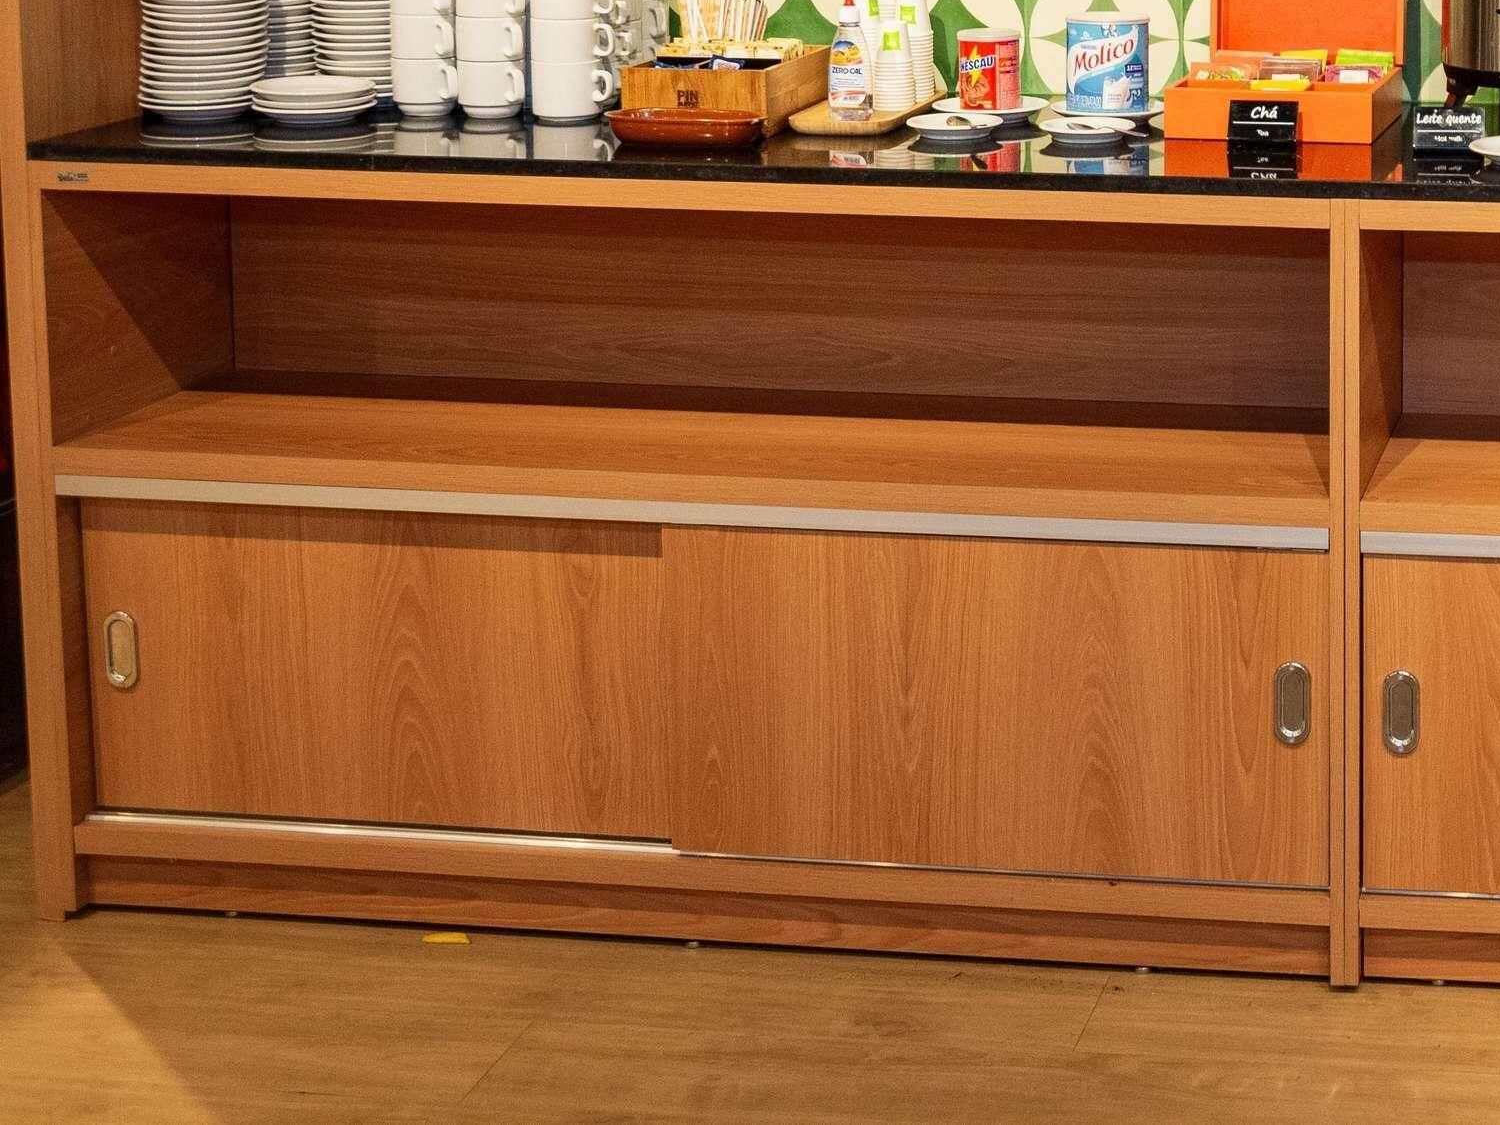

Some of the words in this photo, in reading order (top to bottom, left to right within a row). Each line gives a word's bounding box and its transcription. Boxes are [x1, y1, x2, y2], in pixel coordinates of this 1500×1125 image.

[1072, 38, 1134, 77] Molico
[1250, 105, 1279, 119] Chá
[1416, 108, 1443, 124] Leite
[1445, 112, 1482, 127] quente
